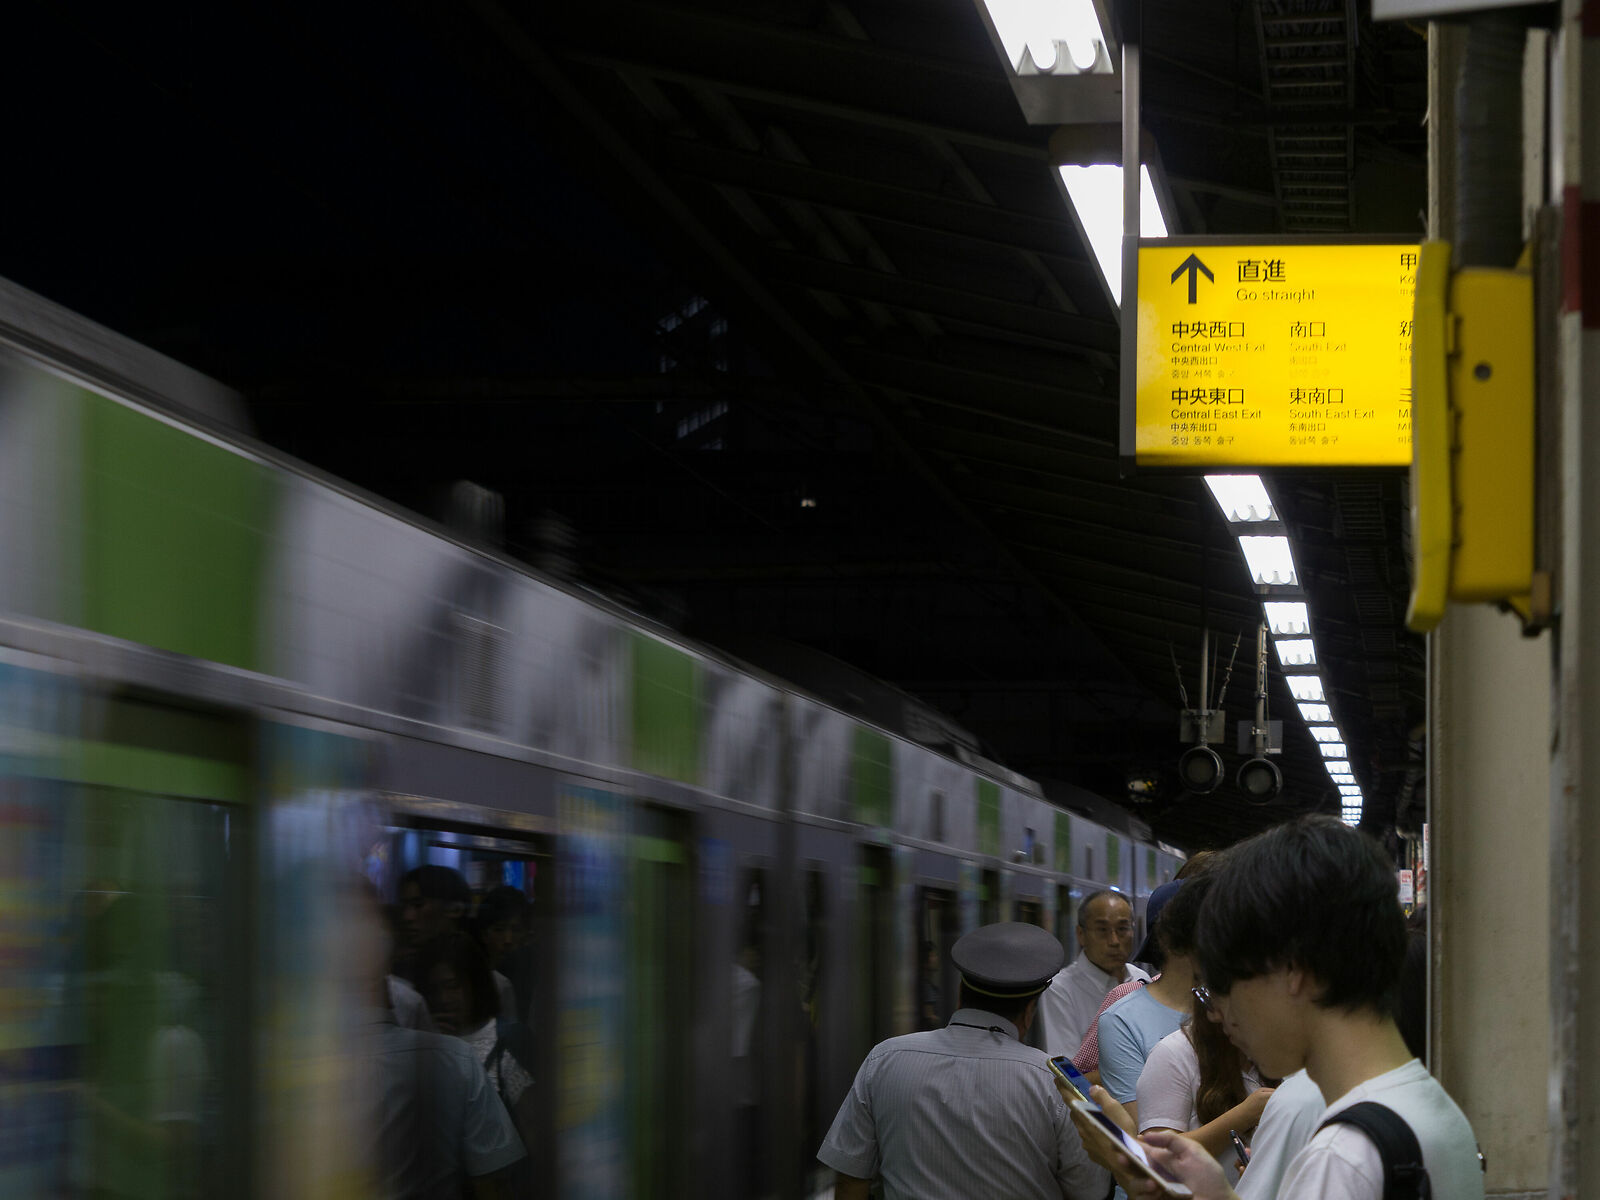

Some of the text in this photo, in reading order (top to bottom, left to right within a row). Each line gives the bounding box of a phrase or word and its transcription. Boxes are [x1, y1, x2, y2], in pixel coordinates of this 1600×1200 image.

[1237, 259, 1286, 283] 直進
[1236, 288, 1315, 305] Go straight
[1171, 320, 1245, 339] 中央西口
[1289, 320, 1326, 338] 南口
[1171, 342, 1211, 353] Central
[1214, 342, 1242, 353] West
[1171, 356, 1218, 366] 中央西出口
[1170, 386, 1245, 405] 中央東口
[1288, 387, 1344, 405] 東南口
[1170, 408, 1262, 420] Central East Exit
[1289, 408, 1375, 420] South East Exit
[1170, 422, 1217, 432] 中央东出口
[1288, 422, 1326, 432] 东南出口
